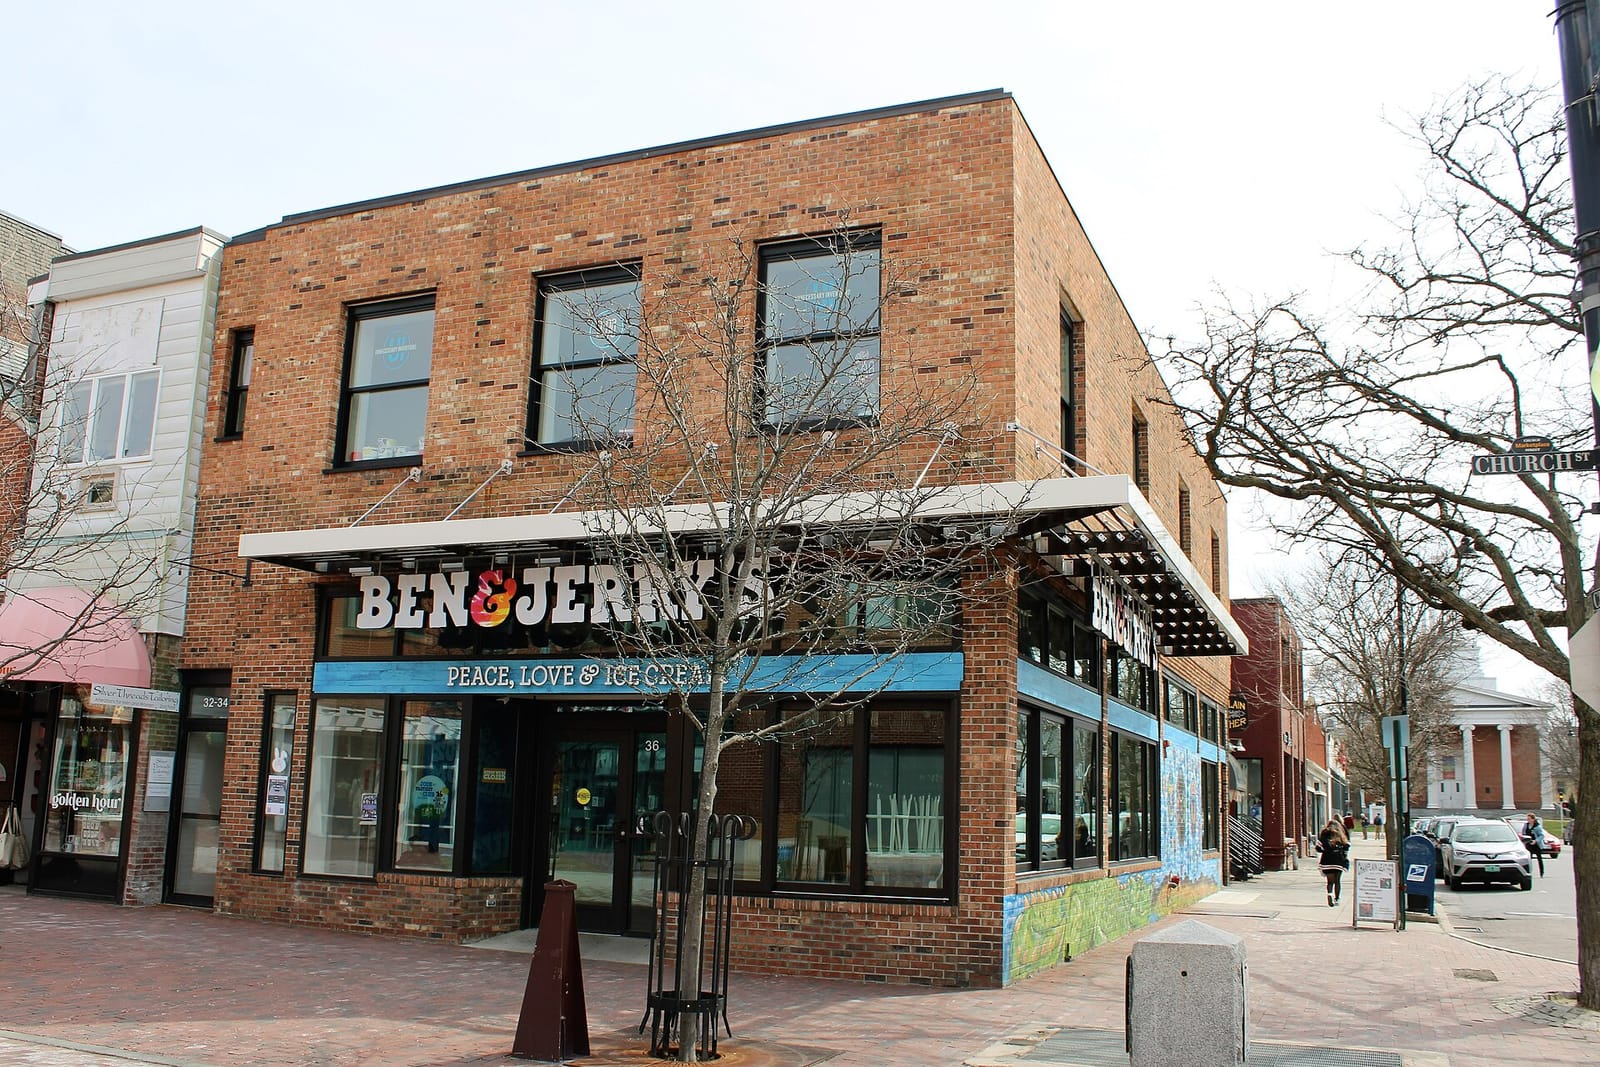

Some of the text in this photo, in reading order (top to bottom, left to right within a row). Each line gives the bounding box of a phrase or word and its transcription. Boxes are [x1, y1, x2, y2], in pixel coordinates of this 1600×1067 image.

[1475, 452, 1591, 474] CHURCH ST
[447, 664, 728, 689] PEACE, LOVE & ICE CREA
[116, 687, 149, 701] Threads
[203, 697, 229, 708] 32-34
[1228, 700, 1246, 711] LAIN
[1228, 717, 1247, 729] HER
[644, 739, 661, 752] 36
[51, 792, 122, 813] golden hour
